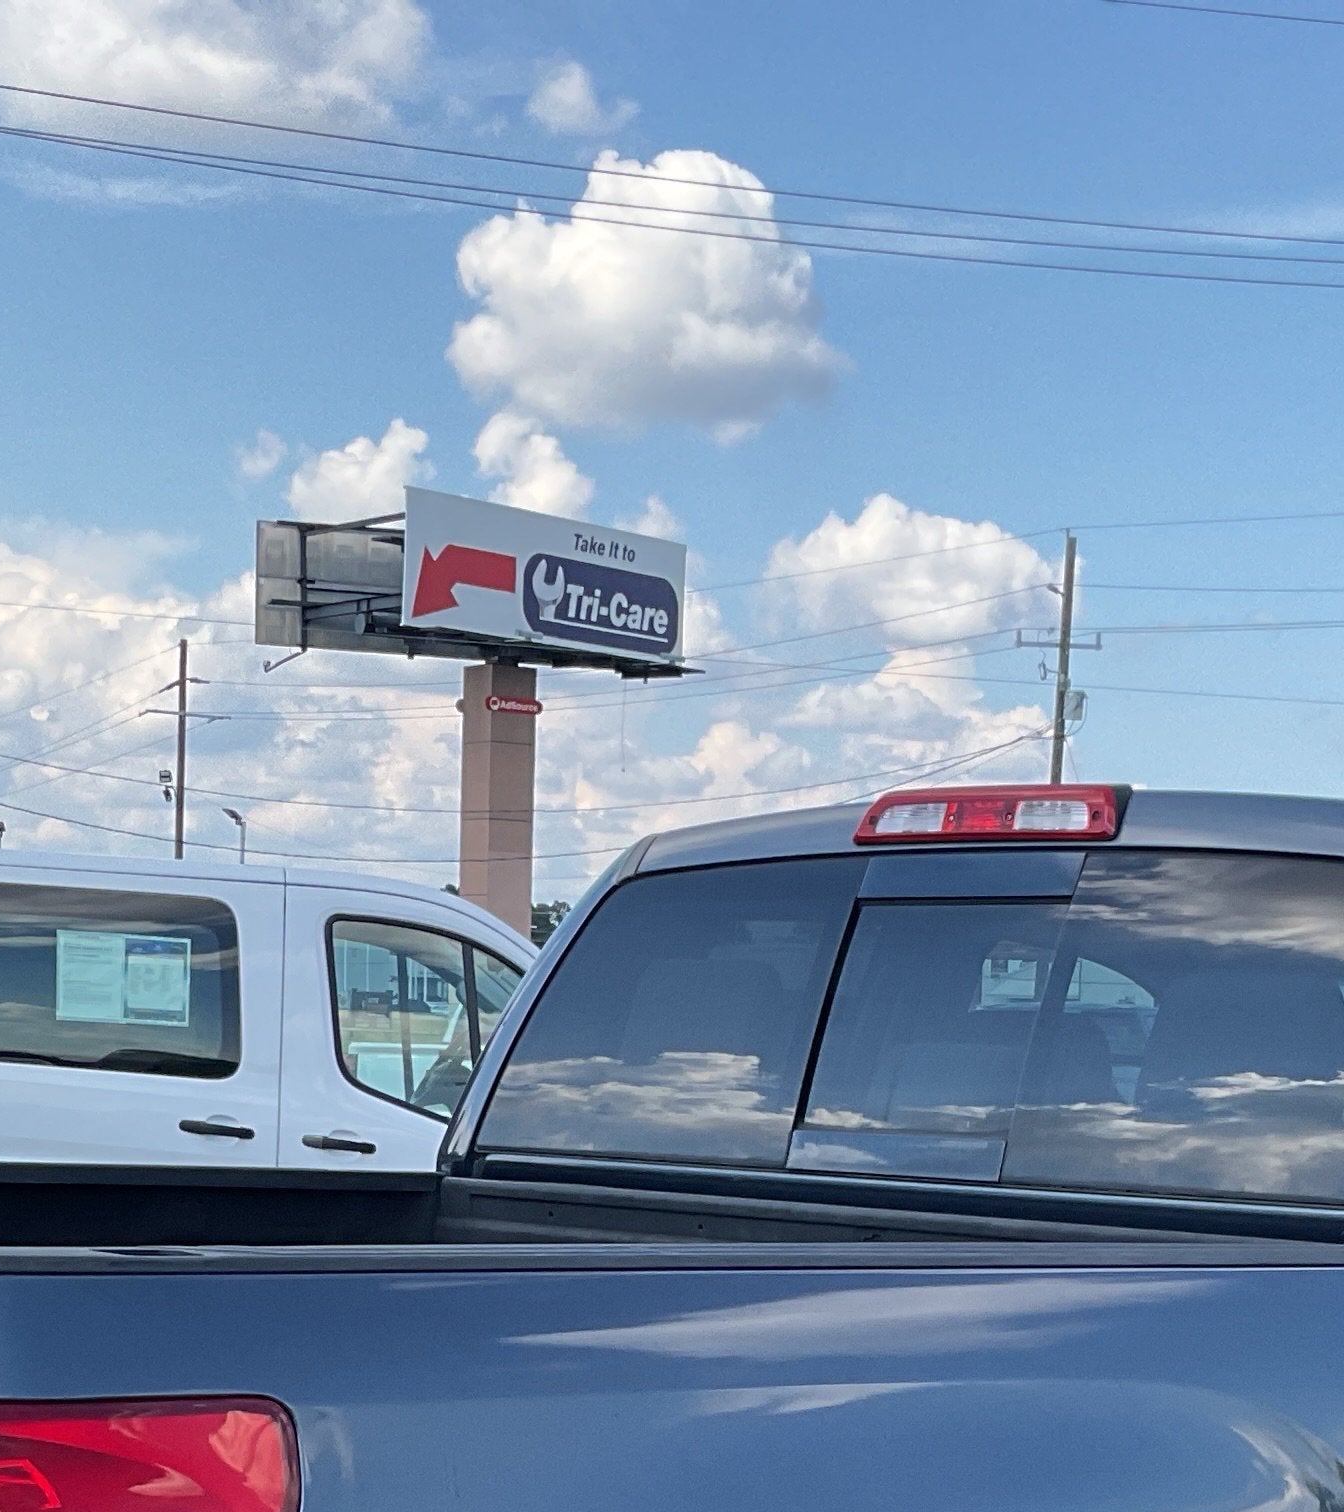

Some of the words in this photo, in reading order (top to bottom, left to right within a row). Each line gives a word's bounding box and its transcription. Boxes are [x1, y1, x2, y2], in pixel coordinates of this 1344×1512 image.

[573, 532, 606, 558] Take
[608, 541, 620, 560] It
[622, 545, 636, 563] to
[565, 583, 669, 634] Tri-Care
